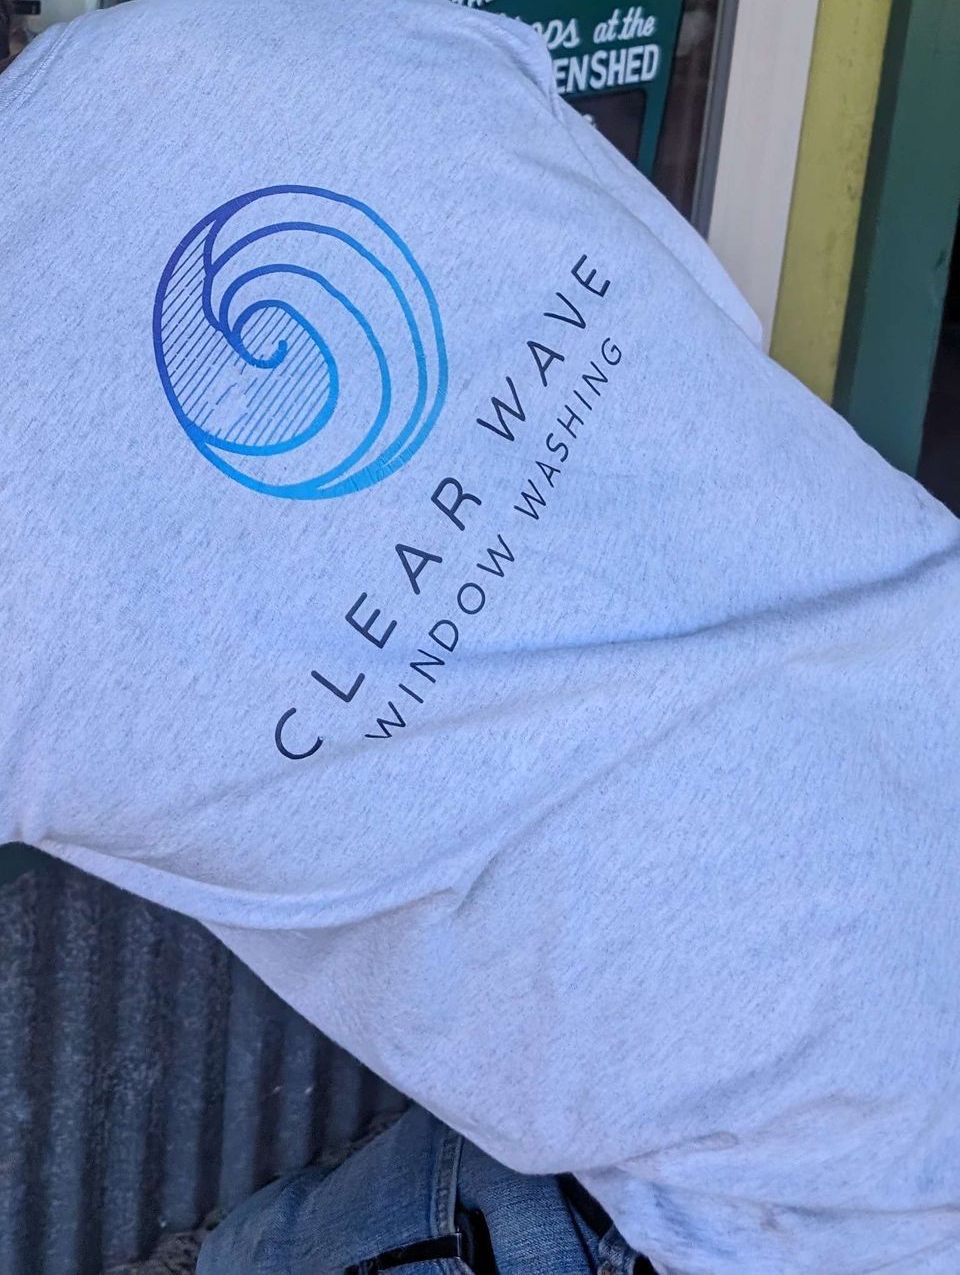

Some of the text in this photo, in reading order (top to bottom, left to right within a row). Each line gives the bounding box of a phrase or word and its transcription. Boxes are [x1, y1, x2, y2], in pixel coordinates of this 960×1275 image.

[593, 8, 619, 44] at
[617, 6, 656, 40] the
[274, 477, 482, 760] CLEAR
[475, 254, 611, 442] WAVE
[364, 337, 623, 740] WINDOW WASHING
